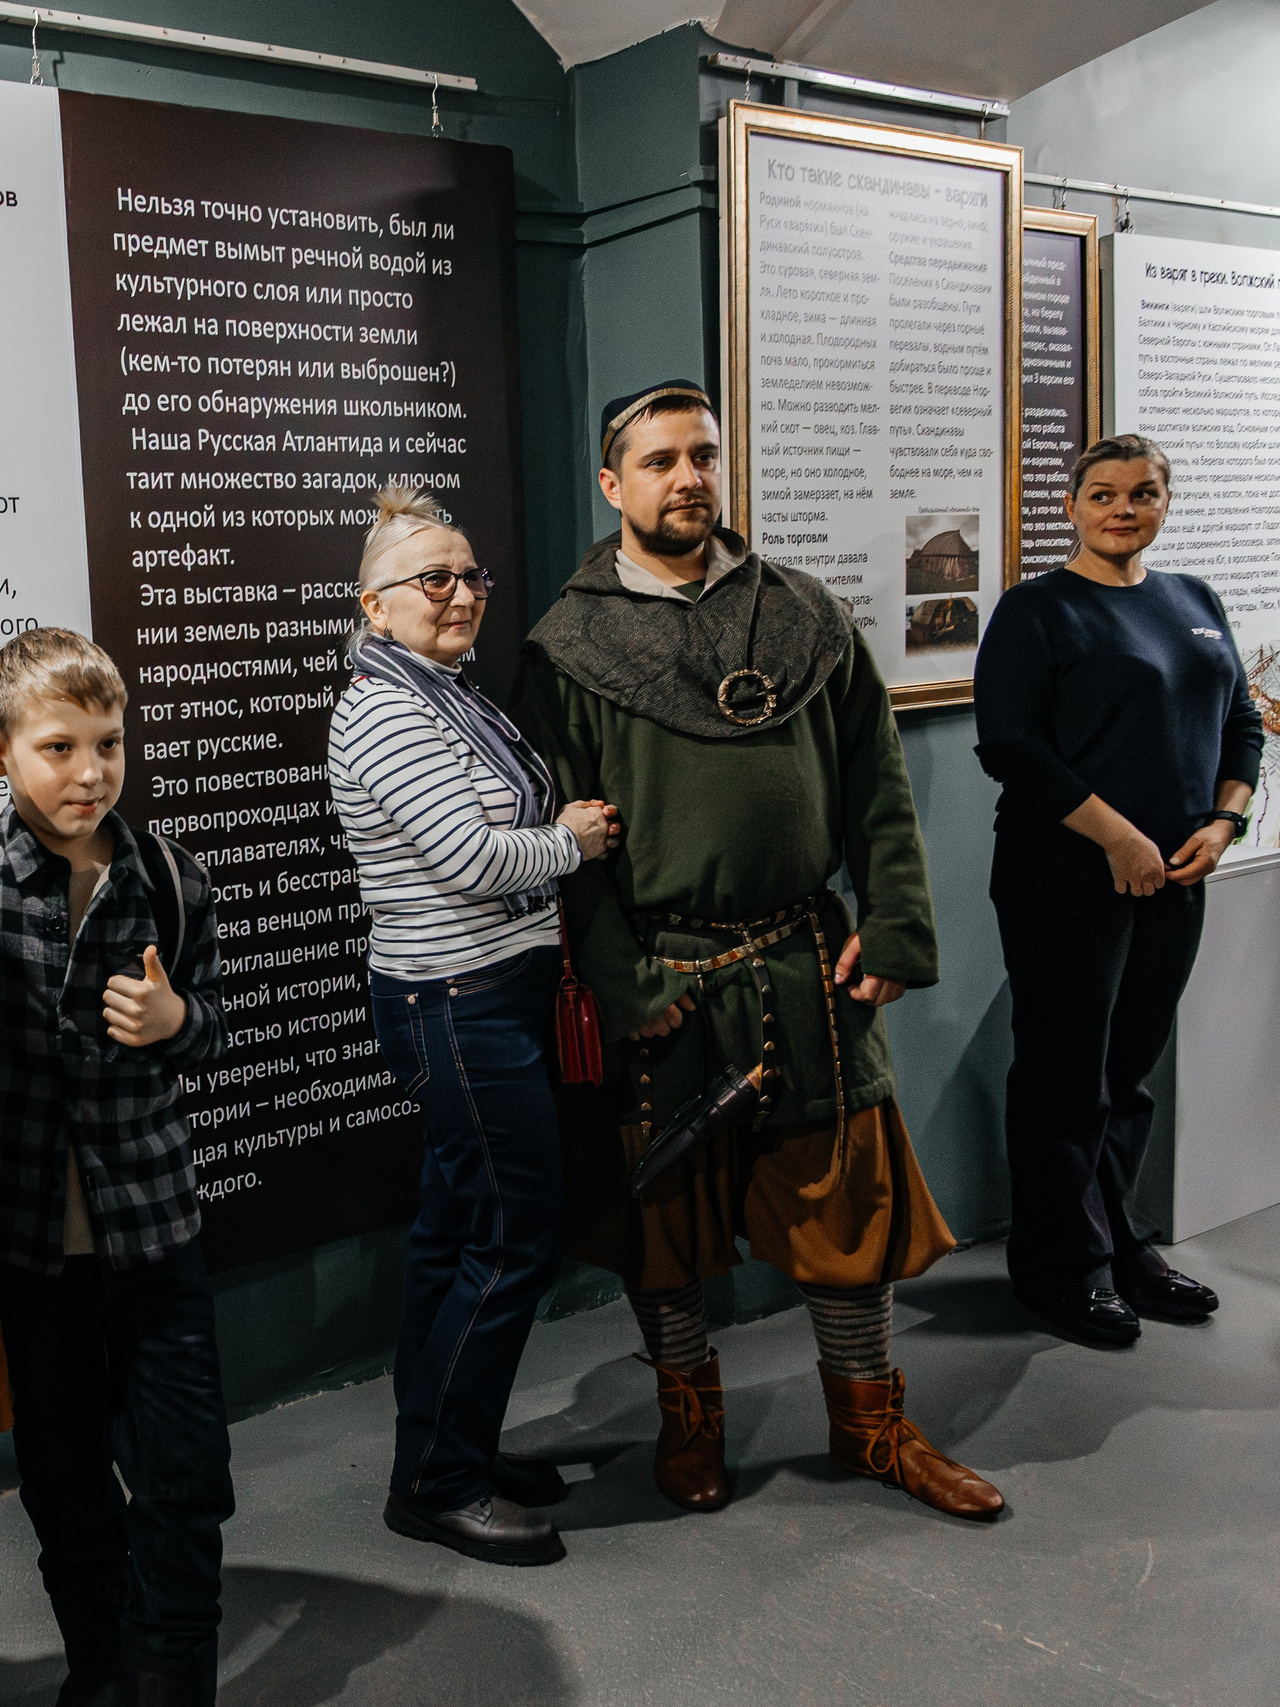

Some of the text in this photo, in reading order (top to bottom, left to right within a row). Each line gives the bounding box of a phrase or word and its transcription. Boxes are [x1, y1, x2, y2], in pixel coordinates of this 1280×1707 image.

[768, 159, 795, 181] Кто
[847, 172, 931, 199] скандинавы
[945, 187, 988, 210] варяги
[117, 186, 454, 240] Нельзя точно установить, был ли
[113, 232, 453, 277] предмет вымыт речной водой из
[115, 273, 413, 312] культурного слоя или просто
[1160, 267, 1188, 285] варяг
[1231, 271, 1275, 289] Волжский
[117, 313, 418, 346] лежал на поверхности земли
[120, 345, 456, 388] (кем-то потерян или выброшен?)
[121, 388, 467, 419] до его обнаружения школьником.
[131, 427, 467, 458] Наша Русская Атлантида и сейчас
[125, 471, 461, 494] таит множество загадок, ключом
[130, 503, 379, 534] к одной из которых мож
[762, 532, 828, 547] Роль торговли
[132, 542, 235, 573] артефакт.
[140, 578, 361, 607] Эта выставка расска
[136, 626, 178, 646] нии
[183, 622, 261, 643] земель
[265, 617, 357, 644] разными
[139, 657, 298, 688] народностями,
[302, 648, 338, 673] чей
[139, 685, 334, 722] тот этнос, который
[143, 732, 283, 761] вает русские.
[151, 775, 189, 798] Это
[148, 800, 321, 839] первопроходцах
[259, 879, 271, 897] и
[257, 906, 333, 934] венцом
[221, 937, 339, 977] риглашение
[276, 973, 361, 1003] истории,
[227, 1006, 366, 1049] астью истории
[206, 1055, 300, 1094] уверены,
[305, 1047, 337, 1067] что
[274, 1065, 397, 1113] необходима
[234, 1120, 323, 1158] культуры
[329, 1116, 340, 1133] и
